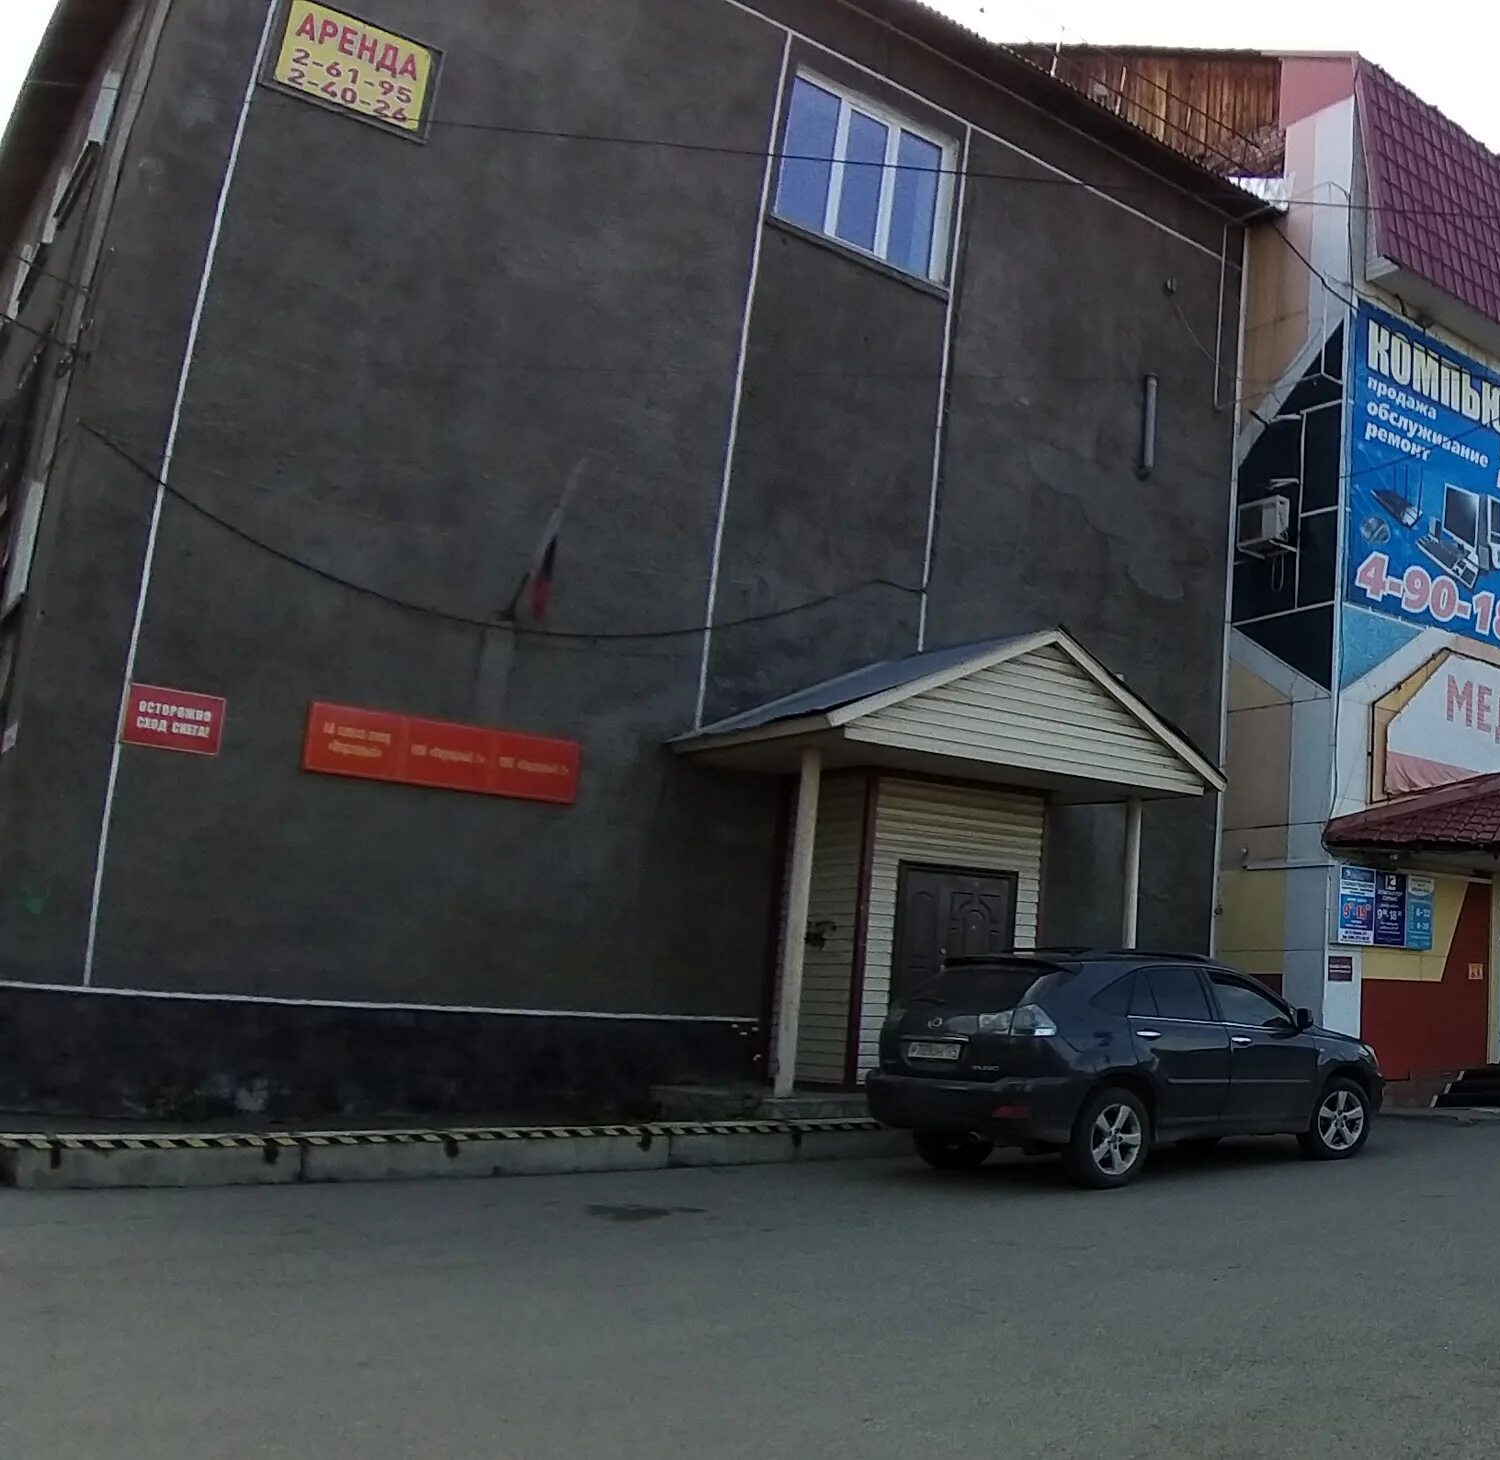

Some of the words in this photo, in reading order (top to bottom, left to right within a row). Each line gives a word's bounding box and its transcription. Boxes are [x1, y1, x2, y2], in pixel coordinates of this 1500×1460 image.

[295, 13, 417, 81] АРЕНДА
[287, 68, 407, 122] 2-40-26
[292, 49, 412, 103] 2-61-95
[1367, 376, 1437, 420] продажа
[1364, 422, 1430, 461] ремонт
[1366, 401, 1489, 468] обслуживание
[136, 716, 167, 733] СХОД
[139, 700, 212, 722] ОСТОРОЖНО
